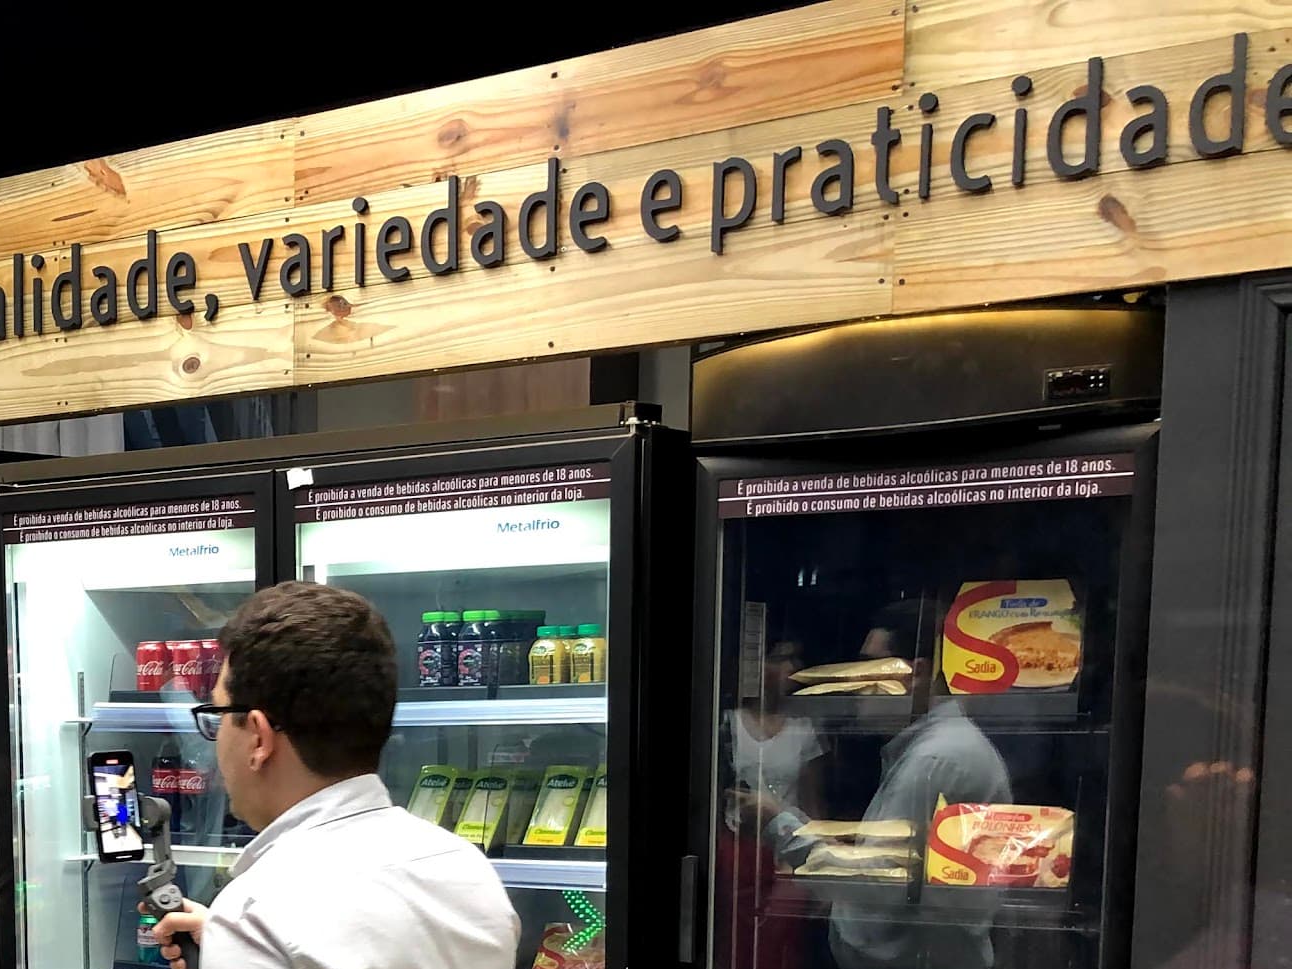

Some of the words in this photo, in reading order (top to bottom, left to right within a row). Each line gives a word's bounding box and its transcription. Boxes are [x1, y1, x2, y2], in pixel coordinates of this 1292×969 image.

[237, 156, 611, 300] variedade
[640, 167, 683, 242] e
[308, 489, 314, 503] É
[314, 487, 349, 505] proibida
[350, 488, 356, 499] a
[356, 484, 382, 498] venda
[383, 484, 395, 496] de
[396, 481, 430, 495] bebidas
[431, 477, 477, 493] alcoólicas
[478, 477, 499, 490] para
[500, 471, 541, 485] menores
[542, 469, 554, 482] de
[556, 468, 566, 481] 18
[568, 467, 594, 479] anos.
[737, 480, 744, 495] É
[746, 479, 790, 497] proibida
[792, 480, 799, 492] a
[801, 476, 834, 490] venda
[836, 475, 850, 489] de
[852, 472, 897, 487] bebidas
[899, 468, 958, 485] alcoólicas
[961, 470, 988, 484] para
[990, 463, 1044, 478] menores
[1046, 460, 1062, 475] de
[1065, 459, 1078, 473] 18
[1081, 458, 1116, 472] anos.
[315, 507, 321, 521] É
[322, 505, 357, 522] proibido
[358, 507, 363, 517] o
[365, 504, 403, 516] consumo
[404, 501, 415, 513] de
[417, 498, 452, 512] bebidas
[453, 494, 499, 510] alcoólicas
[500, 494, 512, 505] no
[514, 489, 549, 504] interior
[550, 488, 563, 501] da
[564, 486, 585, 502] loja.
[746, 500, 753, 515] É
[755, 499, 799, 517] proibido
[801, 500, 808, 512] o
[810, 498, 859, 512] consumo
[862, 496, 876, 508] de
[879, 493, 924, 507] bebidas
[926, 489, 987, 505] alcoólicas
[989, 489, 1004, 501] no
[1007, 484, 1053, 499] interior
[1056, 482, 1072, 497] da
[1074, 480, 1102, 498] loja.
[18, 513, 46, 528] proibida
[52, 512, 74, 522] venda
[74, 511, 83, 521] de
[83, 508, 112, 520] bebidas
[112, 505, 149, 519] alcoólicas
[149, 506, 166, 519] para
[167, 503, 200, 515] menores
[200, 500, 210, 512] de
[211, 499, 220, 511] 18
[220, 499, 242, 510] anos.
[497, 519, 560, 533] Metalfrio
[25, 529, 53, 544] proibido
[59, 529, 90, 539] consumo
[90, 526, 100, 537] de
[101, 524, 129, 536] bebidas
[129, 520, 167, 535] alcoólicas
[167, 522, 177, 532] no
[178, 518, 206, 530] interior
[207, 517, 217, 529] da
[218, 516, 235, 530] loja.
[169, 544, 220, 557] Metalfrio
[965, 659, 997, 674] Sadia
[941, 865, 970, 881] Sadia
